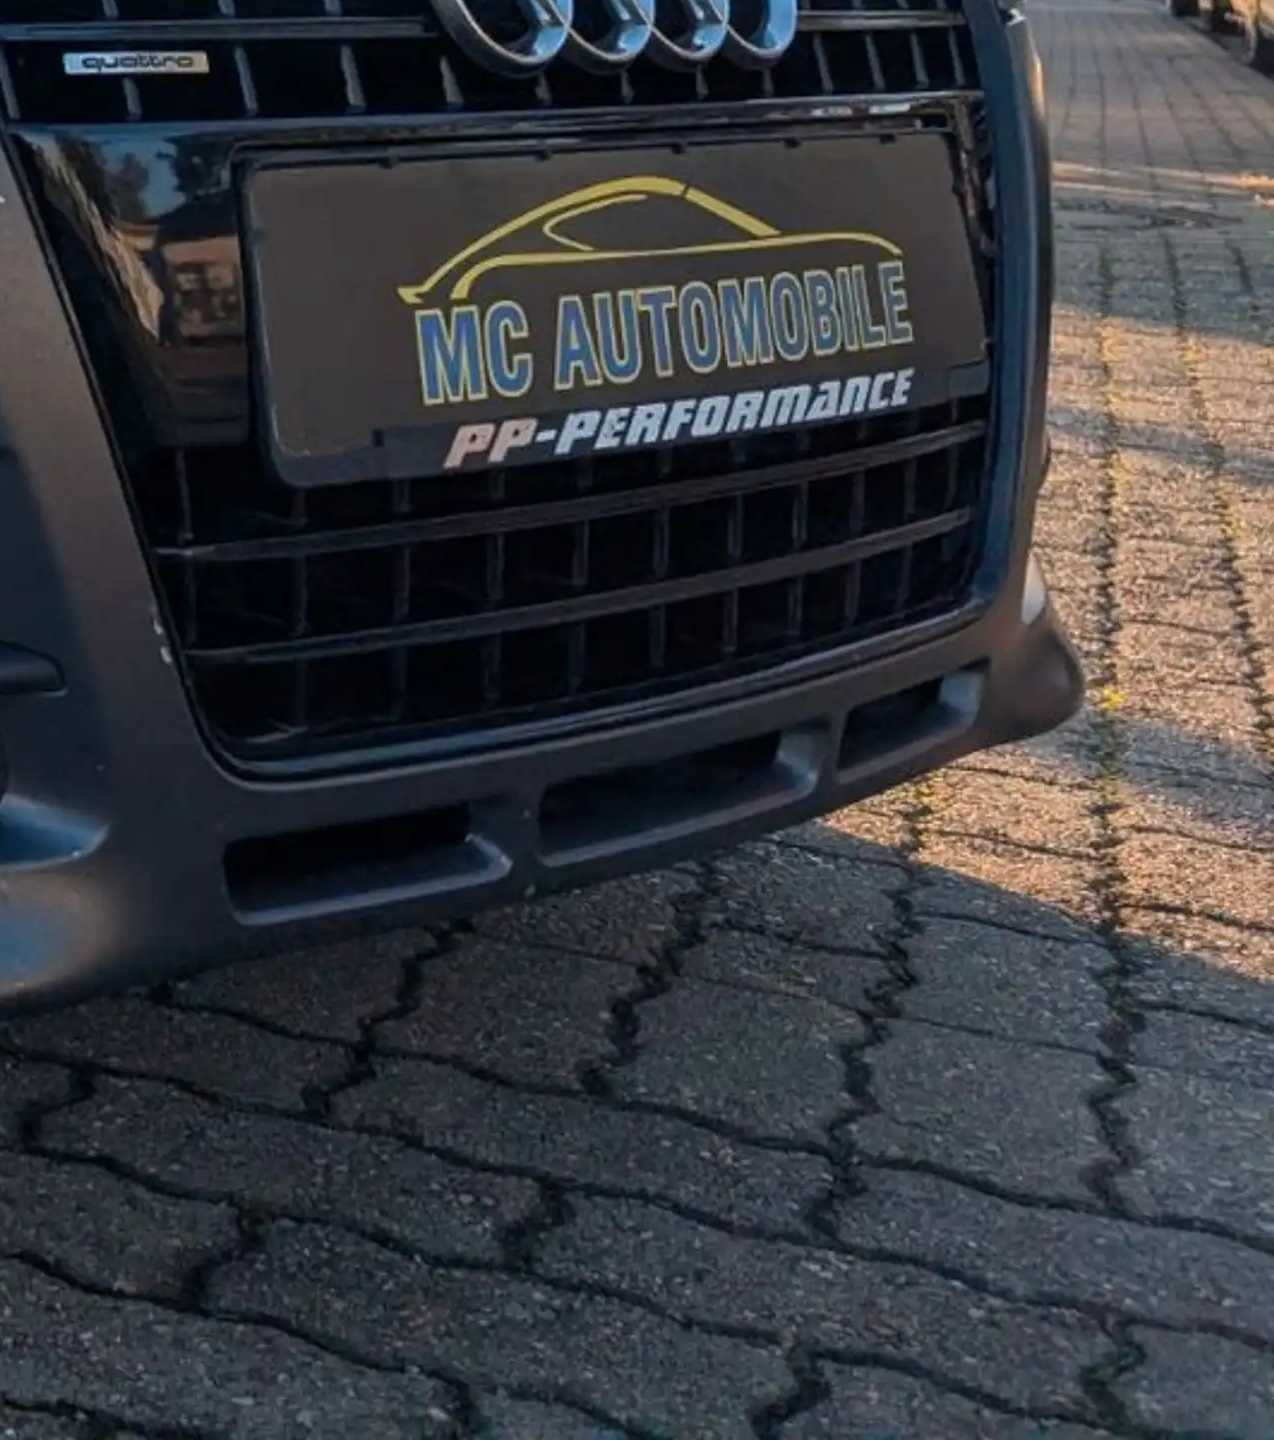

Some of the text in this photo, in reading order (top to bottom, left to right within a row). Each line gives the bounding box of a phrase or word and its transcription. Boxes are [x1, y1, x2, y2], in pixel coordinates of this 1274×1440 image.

[81, 52, 195, 73] quattro
[414, 260, 915, 406] MC AUTOMOBILE
